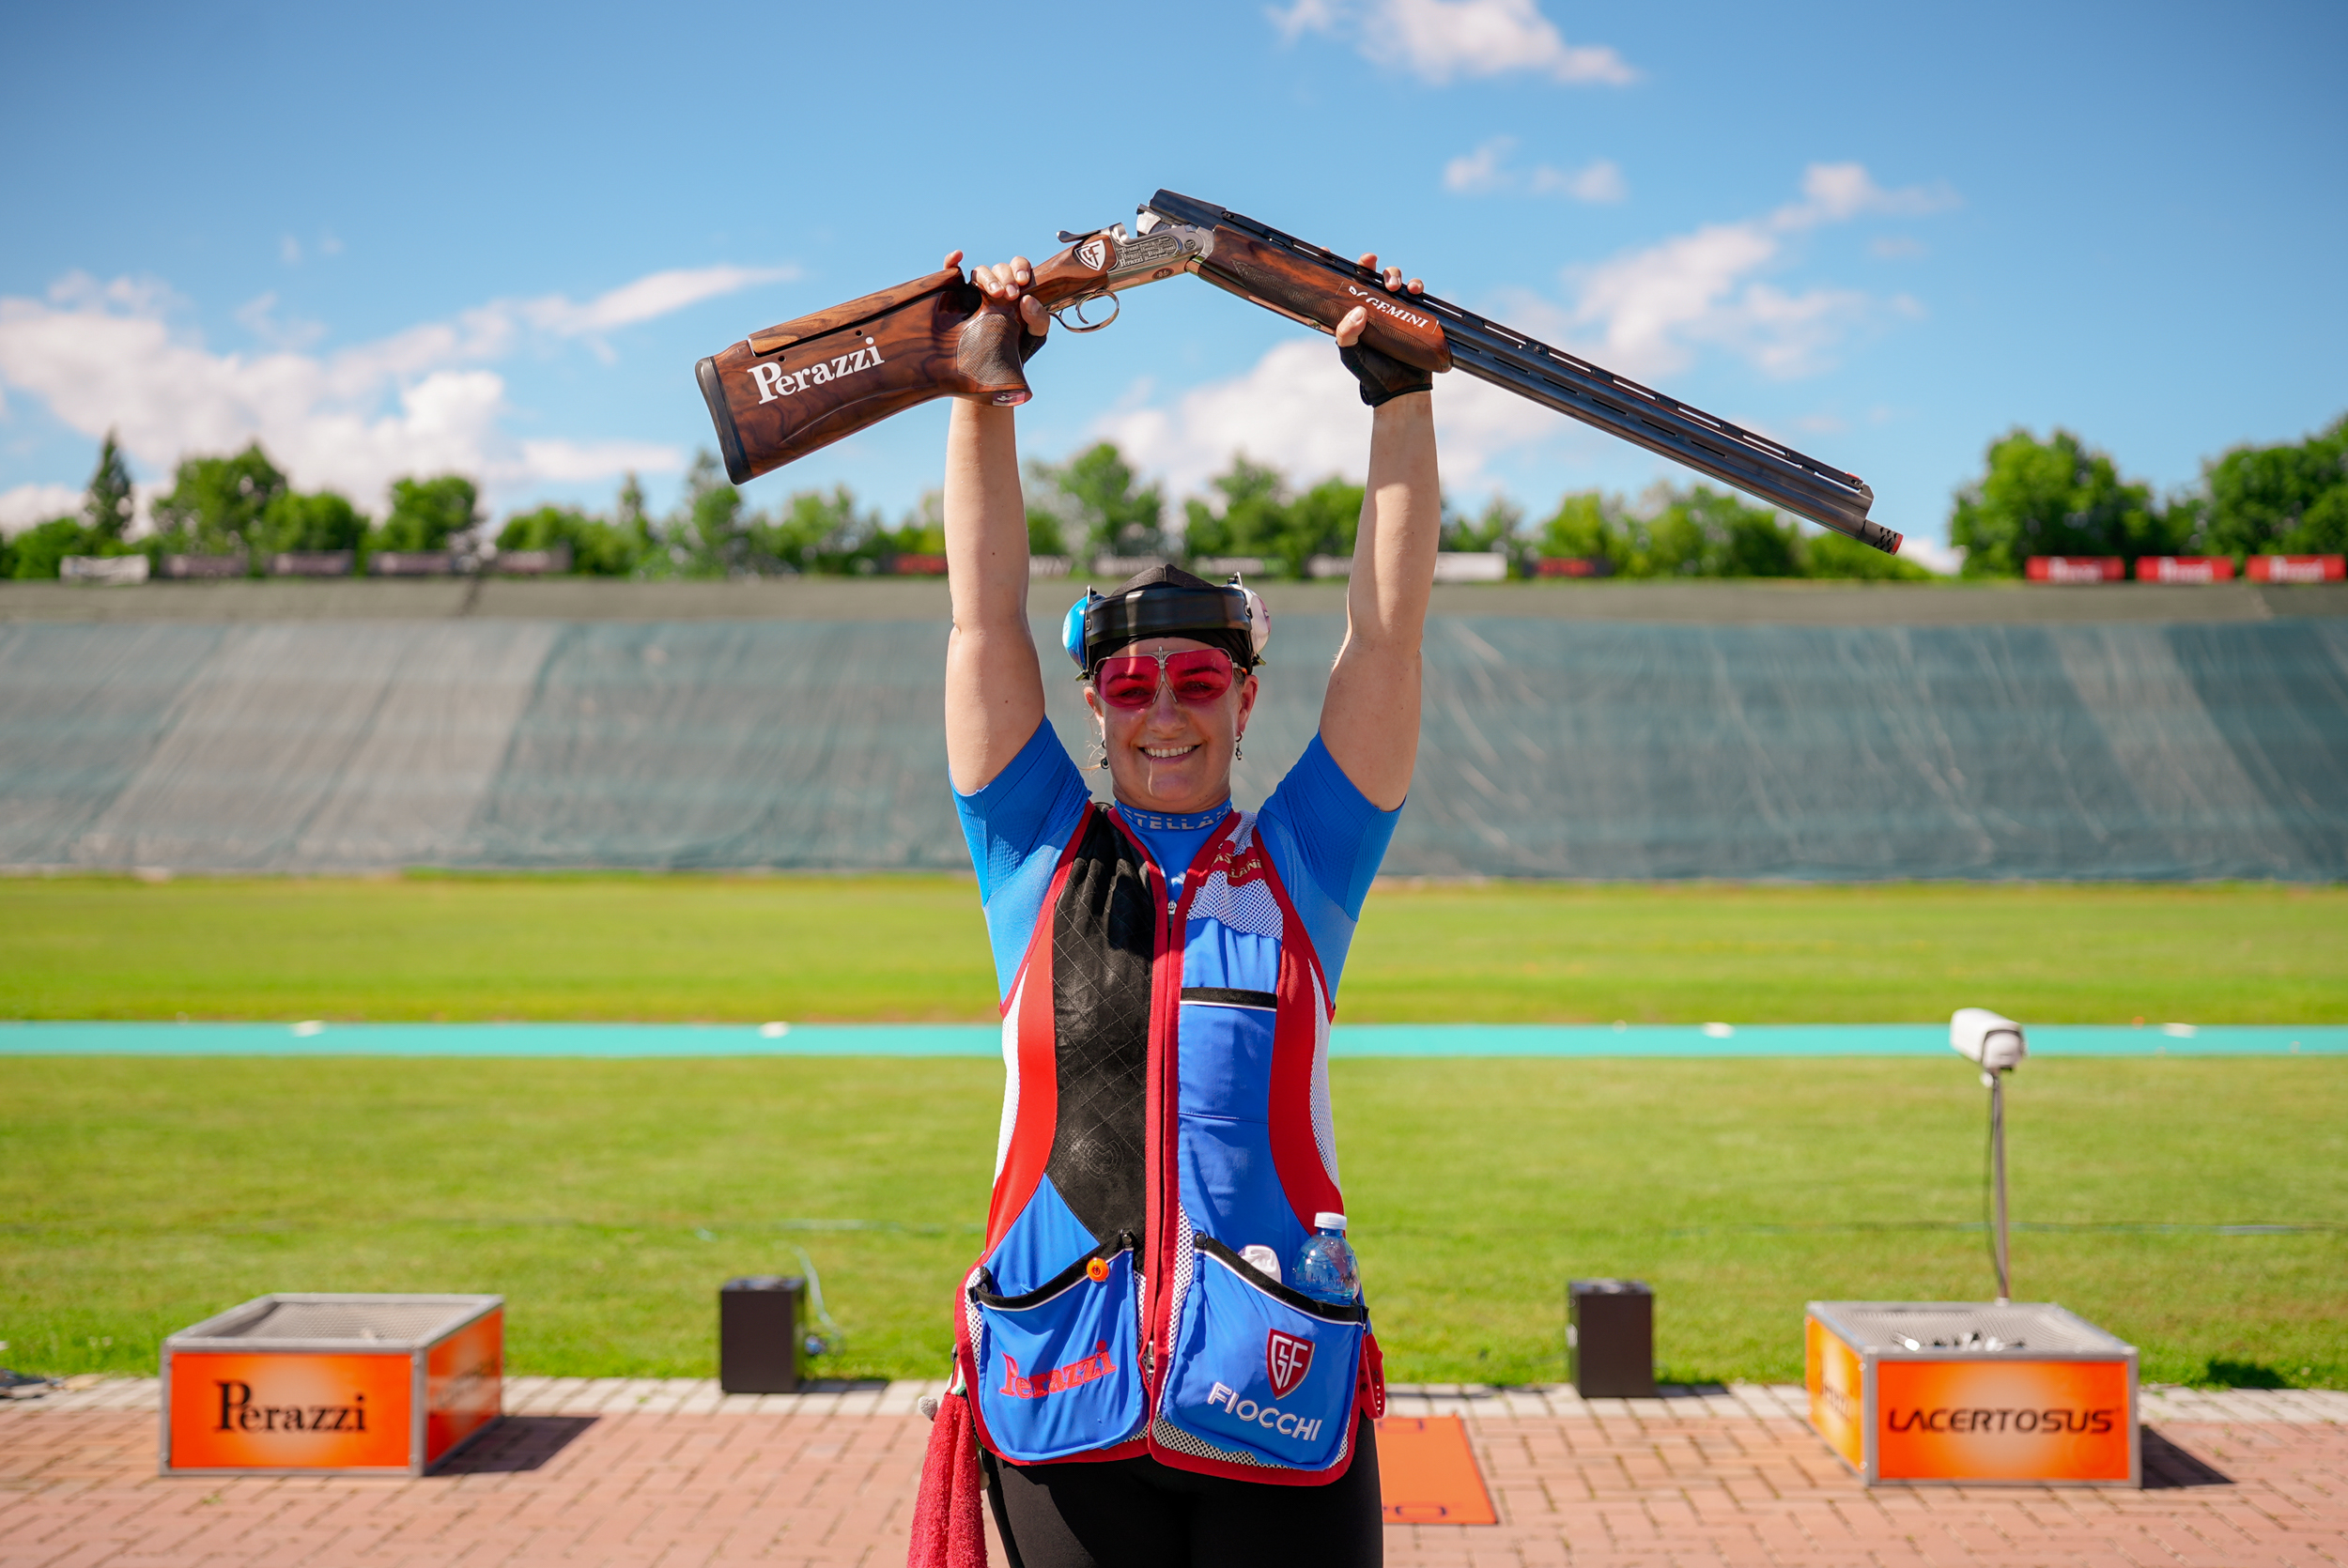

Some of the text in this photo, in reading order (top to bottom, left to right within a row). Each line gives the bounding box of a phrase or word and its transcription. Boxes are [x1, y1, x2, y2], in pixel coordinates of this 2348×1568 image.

[1366, 297, 1429, 329] GEMINI
[747, 336, 886, 405] Perazzi
[999, 1340, 1118, 1399] Perazzi
[215, 1380, 367, 1433] Perazzi
[1207, 1381, 1322, 1441] FIOCCHI
[1888, 1407, 2115, 1434] LACERTOSUS
